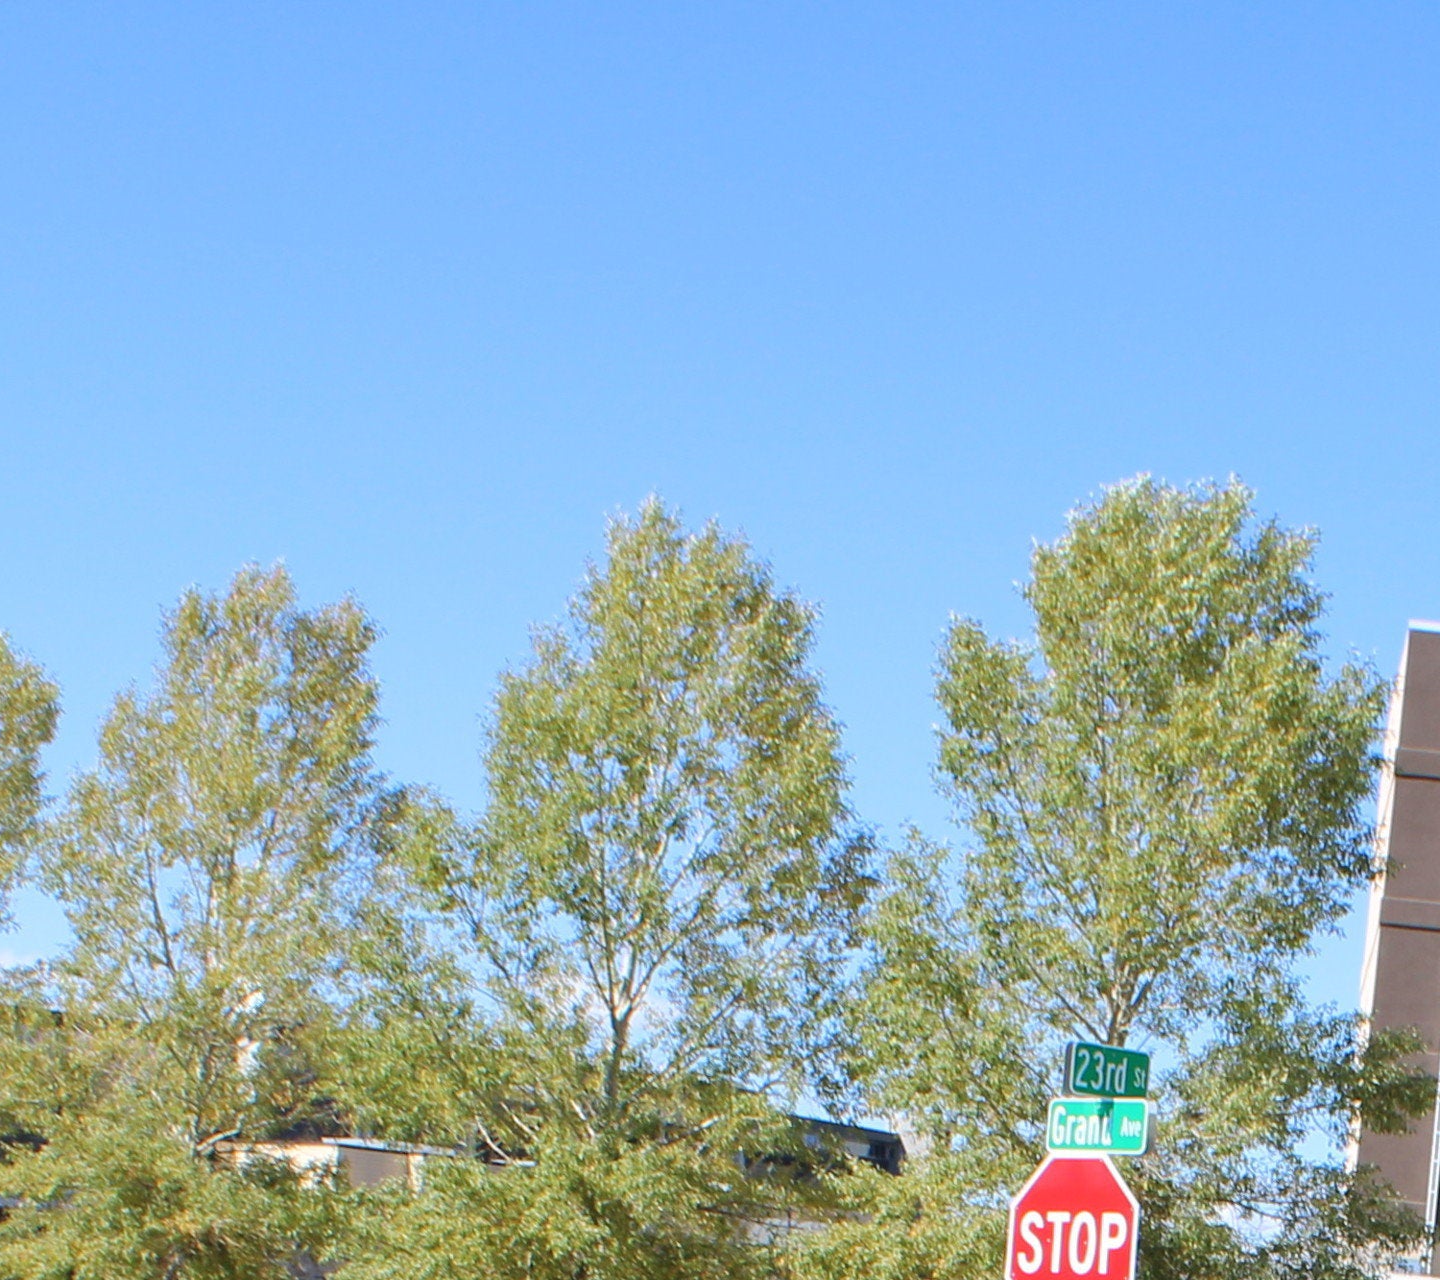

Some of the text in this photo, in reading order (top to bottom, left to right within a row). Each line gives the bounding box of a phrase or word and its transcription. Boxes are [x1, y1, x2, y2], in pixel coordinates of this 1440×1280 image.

[1074, 1047, 1146, 1094] 23rd St
[1051, 1105, 1142, 1146] Grand Ave
[1016, 1210, 1128, 1275] STOP
